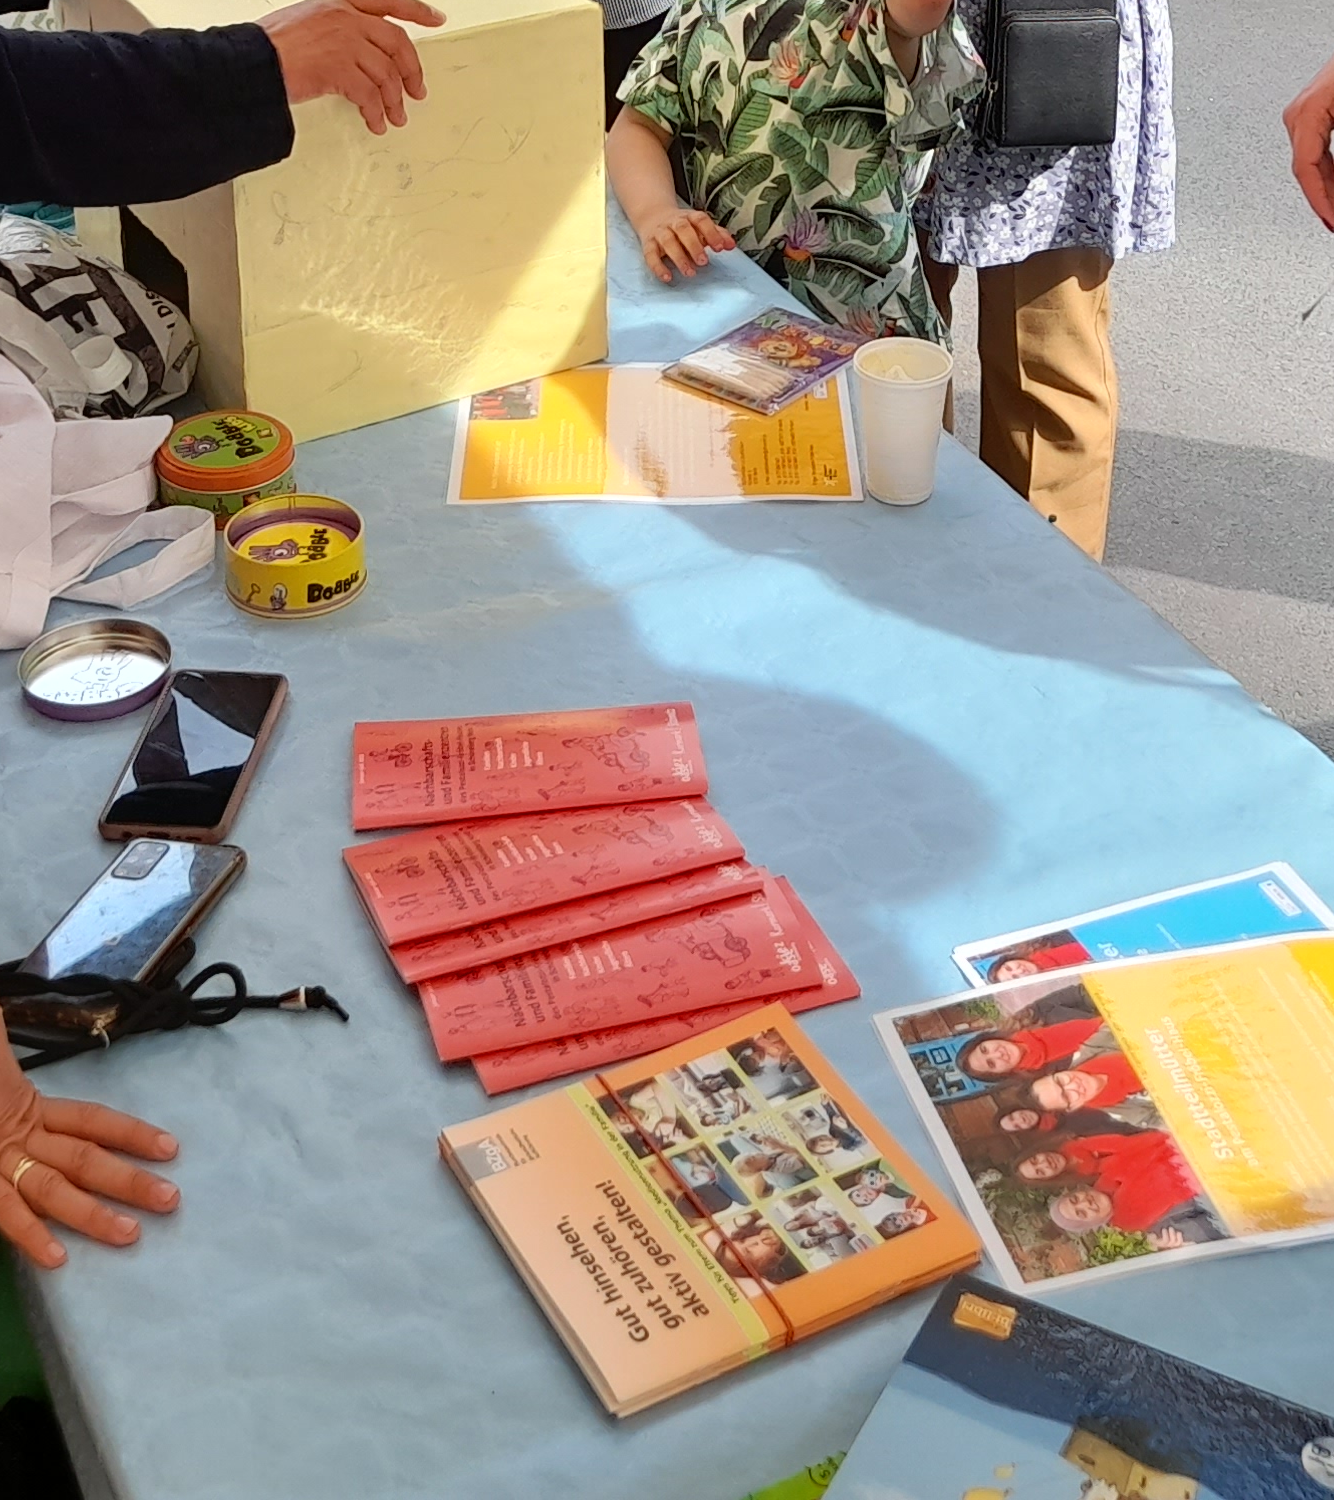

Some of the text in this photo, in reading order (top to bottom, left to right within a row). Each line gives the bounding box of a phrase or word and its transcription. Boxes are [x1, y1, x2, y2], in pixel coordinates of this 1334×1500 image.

[299, 528, 330, 564] OBBLE
[474, 1136, 511, 1172] BZgA
[1138, 1026, 1235, 1159] Stadtteilmütter
[547, 1214, 653, 1343] Gut hinsehen,
[585, 1214, 687, 1331] gut zuhören,
[593, 1178, 711, 1320] aktiv gestalten!
